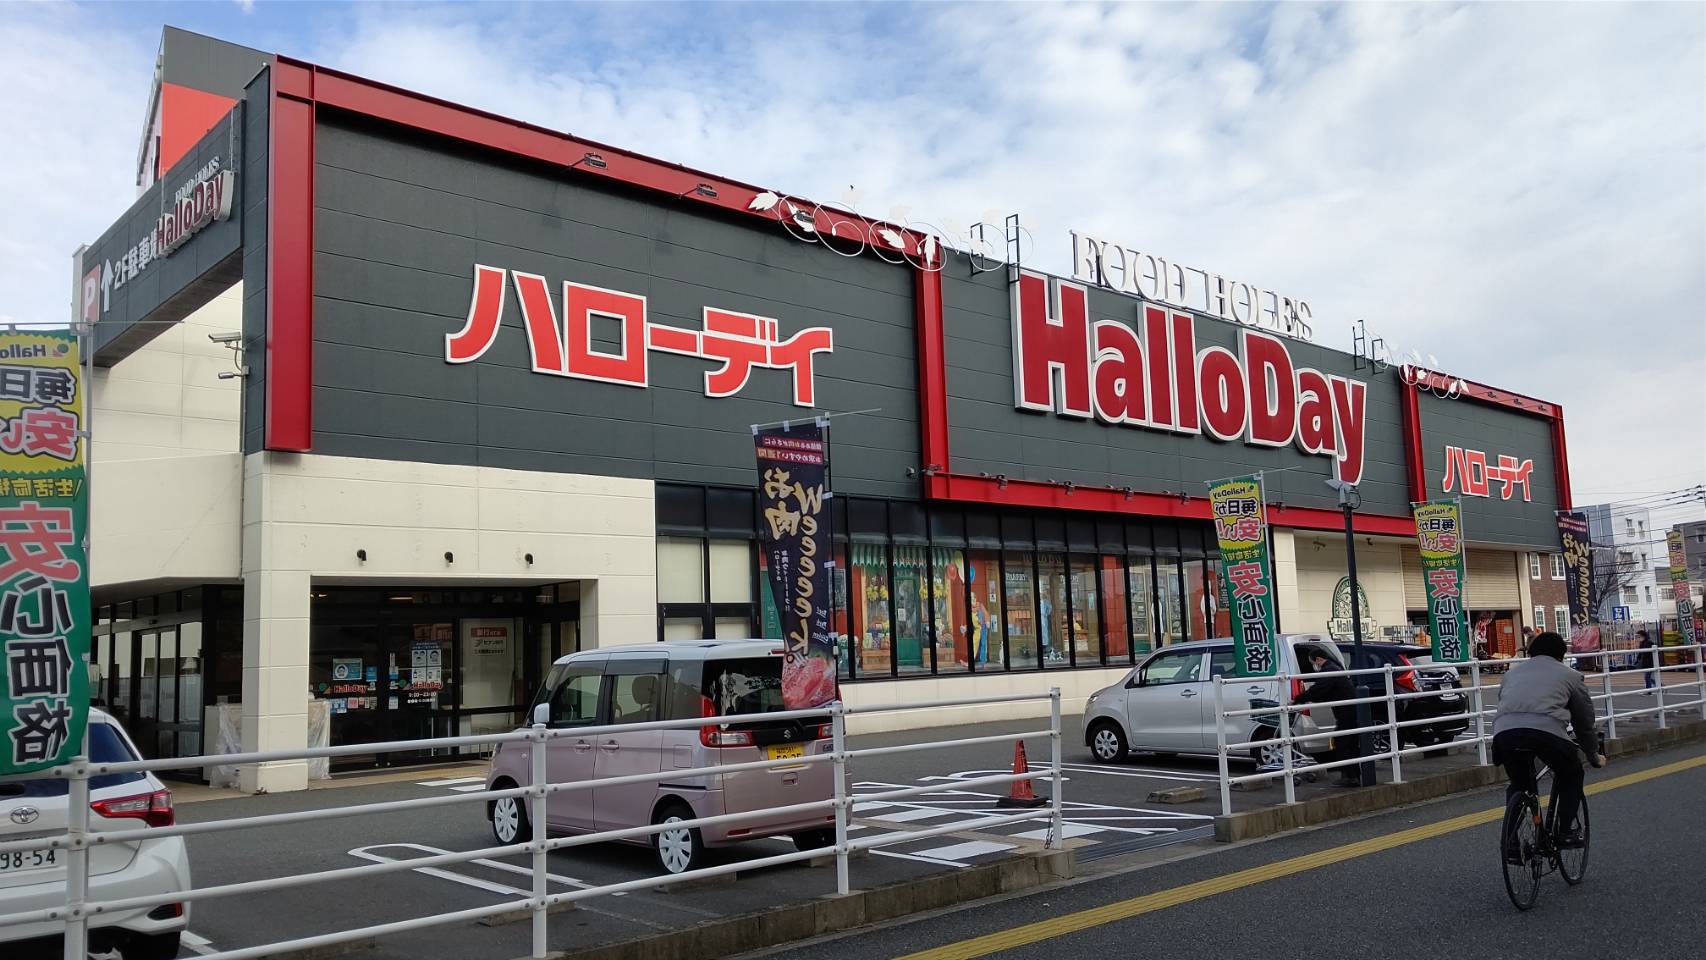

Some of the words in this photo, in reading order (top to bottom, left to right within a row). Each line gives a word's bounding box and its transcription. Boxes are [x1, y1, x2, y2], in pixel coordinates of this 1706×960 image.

[156, 172, 225, 252] HalloDay
[445, 263, 835, 408] ハローデイ
[1011, 269, 1367, 486] HalloDay
[1442, 445, 1534, 503] ハローデイ
